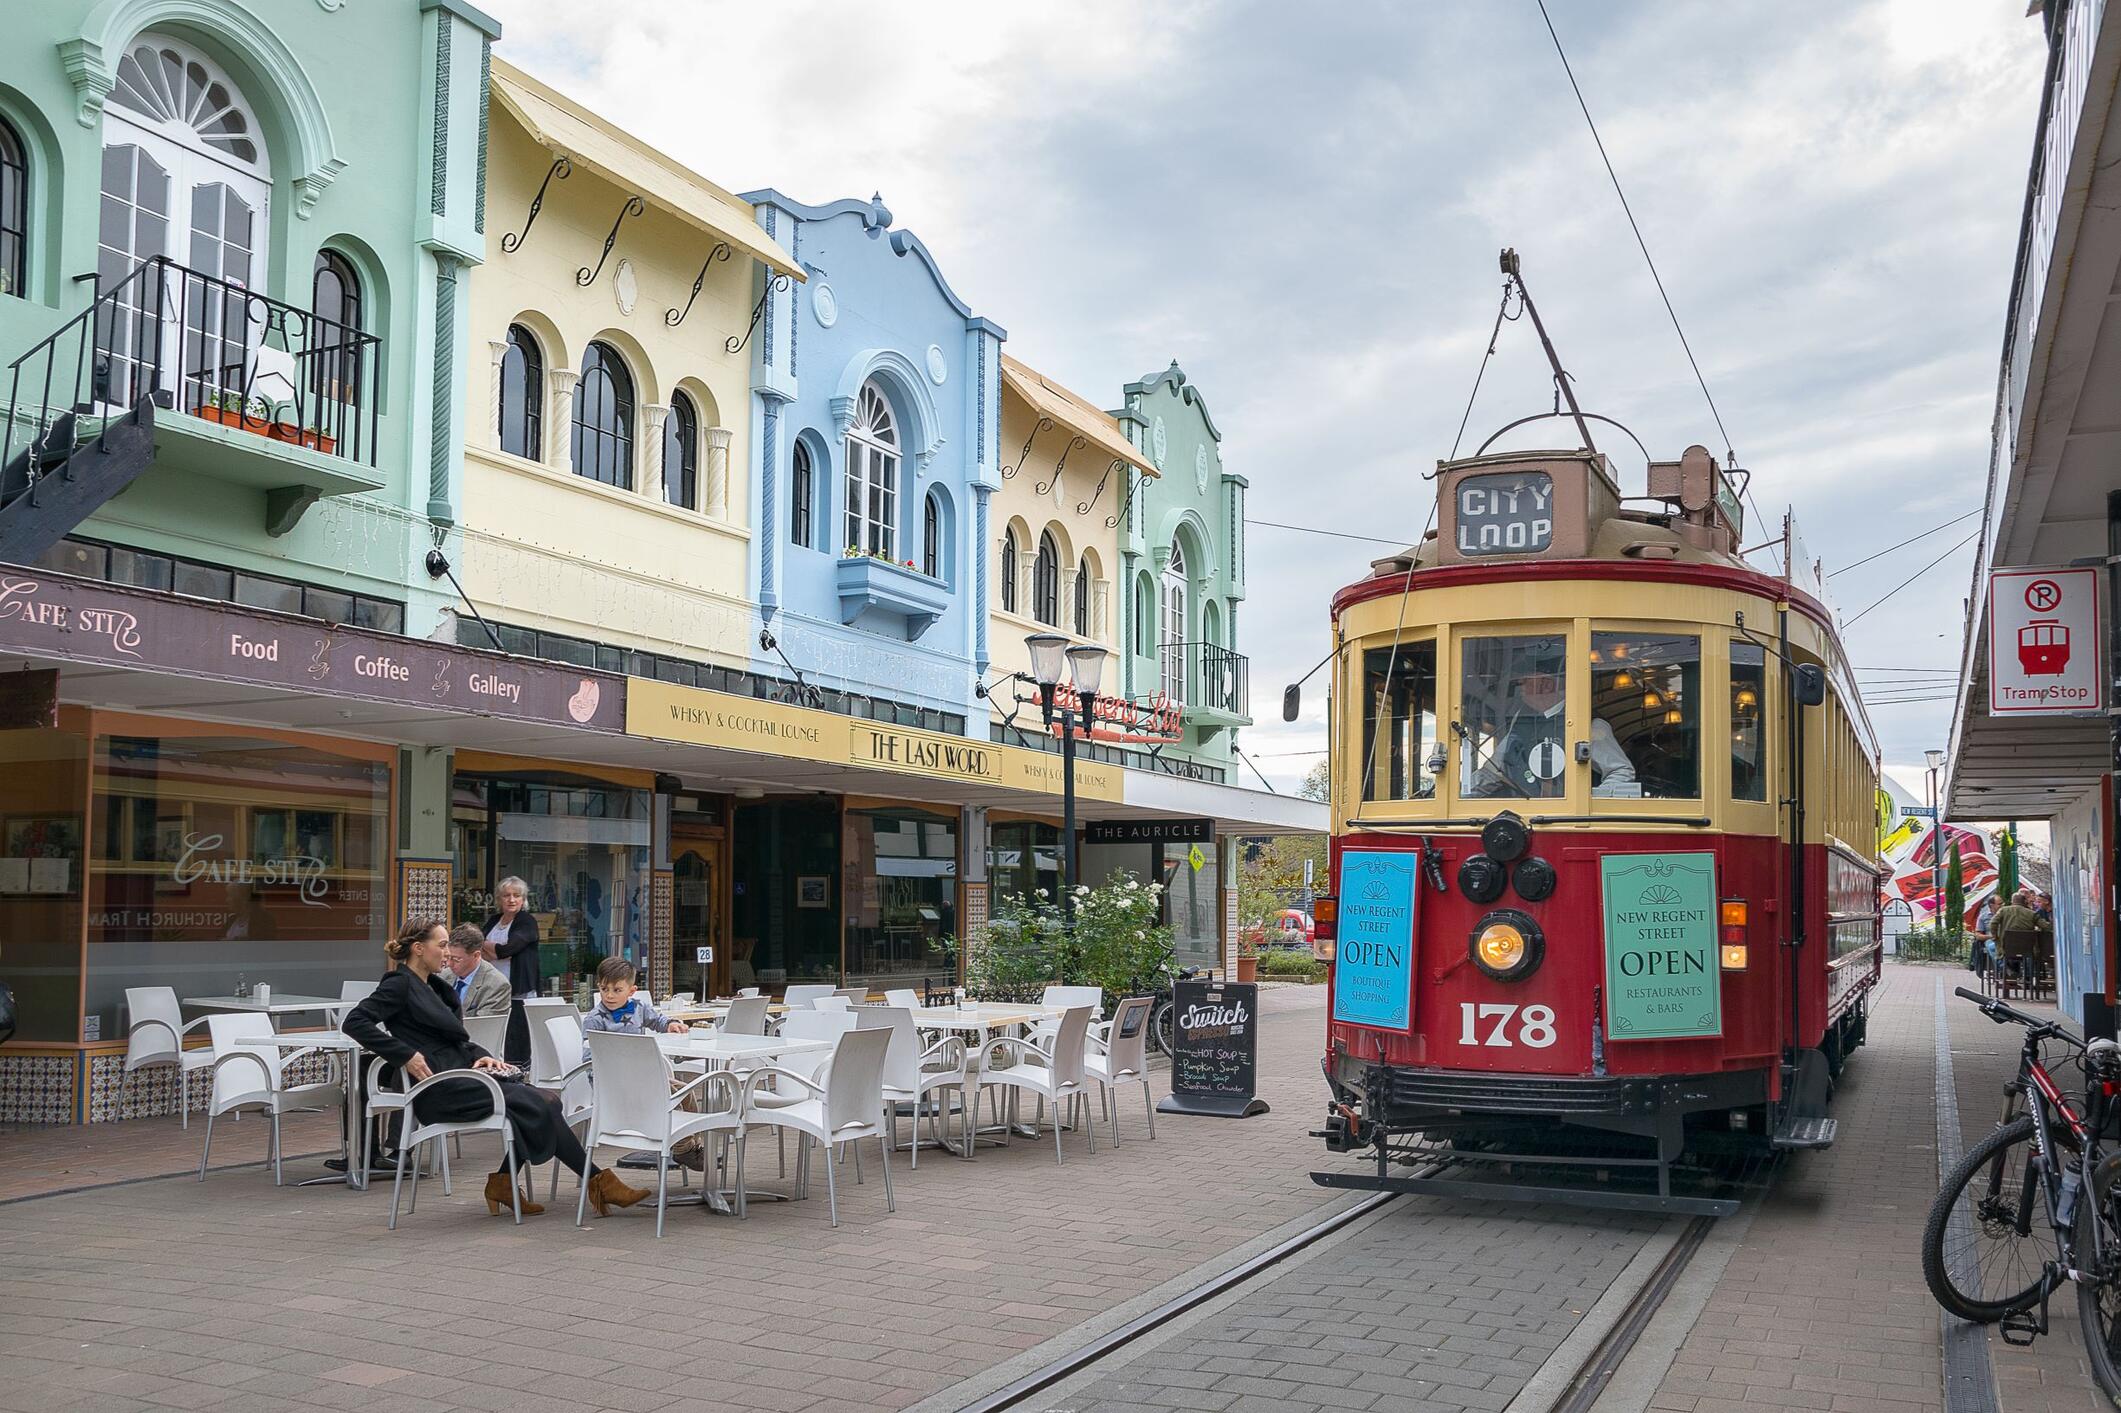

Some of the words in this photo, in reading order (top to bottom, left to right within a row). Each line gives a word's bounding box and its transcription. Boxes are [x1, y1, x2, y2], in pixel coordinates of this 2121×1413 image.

[1463, 483, 1552, 516] CITY
[1460, 519, 1551, 550] LOOP
[231, 634, 279, 662] Food
[354, 655, 410, 682] Coffee
[468, 673, 521, 704] Gallery
[670, 704, 713, 726] WHISKY
[716, 712, 724, 728] &
[727, 714, 778, 737] COCKTAIL
[781, 722, 820, 743] LOUNGE
[870, 732, 899, 762] THE
[905, 738, 942, 769] LAST
[944, 745, 990, 776] WORD.
[1095, 827, 1123, 838] THE
[1130, 825, 1201, 838] AURICLE
[1346, 904, 1367, 916] NEW
[1369, 904, 1406, 919] REGENT
[1616, 911, 1649, 924] NEW
[1652, 909, 1706, 923] REGENT
[1358, 920, 1391, 934] STREET
[1638, 927, 1686, 940] STREET
[699, 949, 711, 961] 28
[1345, 940, 1402, 969] OPEN
[1620, 949, 1705, 977] OPEN
[1352, 975, 1391, 991] BOUTIQUE
[1626, 985, 1703, 999] RESTAURANTS
[1351, 990, 1390, 1005] SHOPPING
[1646, 1003, 1655, 1014] &
[1658, 1002, 1684, 1014] BARS
[1180, 1000, 1248, 1030] Switch
[1458, 1002, 1557, 1049] 178
[1196, 1048, 1214, 1060] HOT
[1183, 1059, 1214, 1072] Pumpkin
[2026, 1086, 2040, 1127] ROCKY
